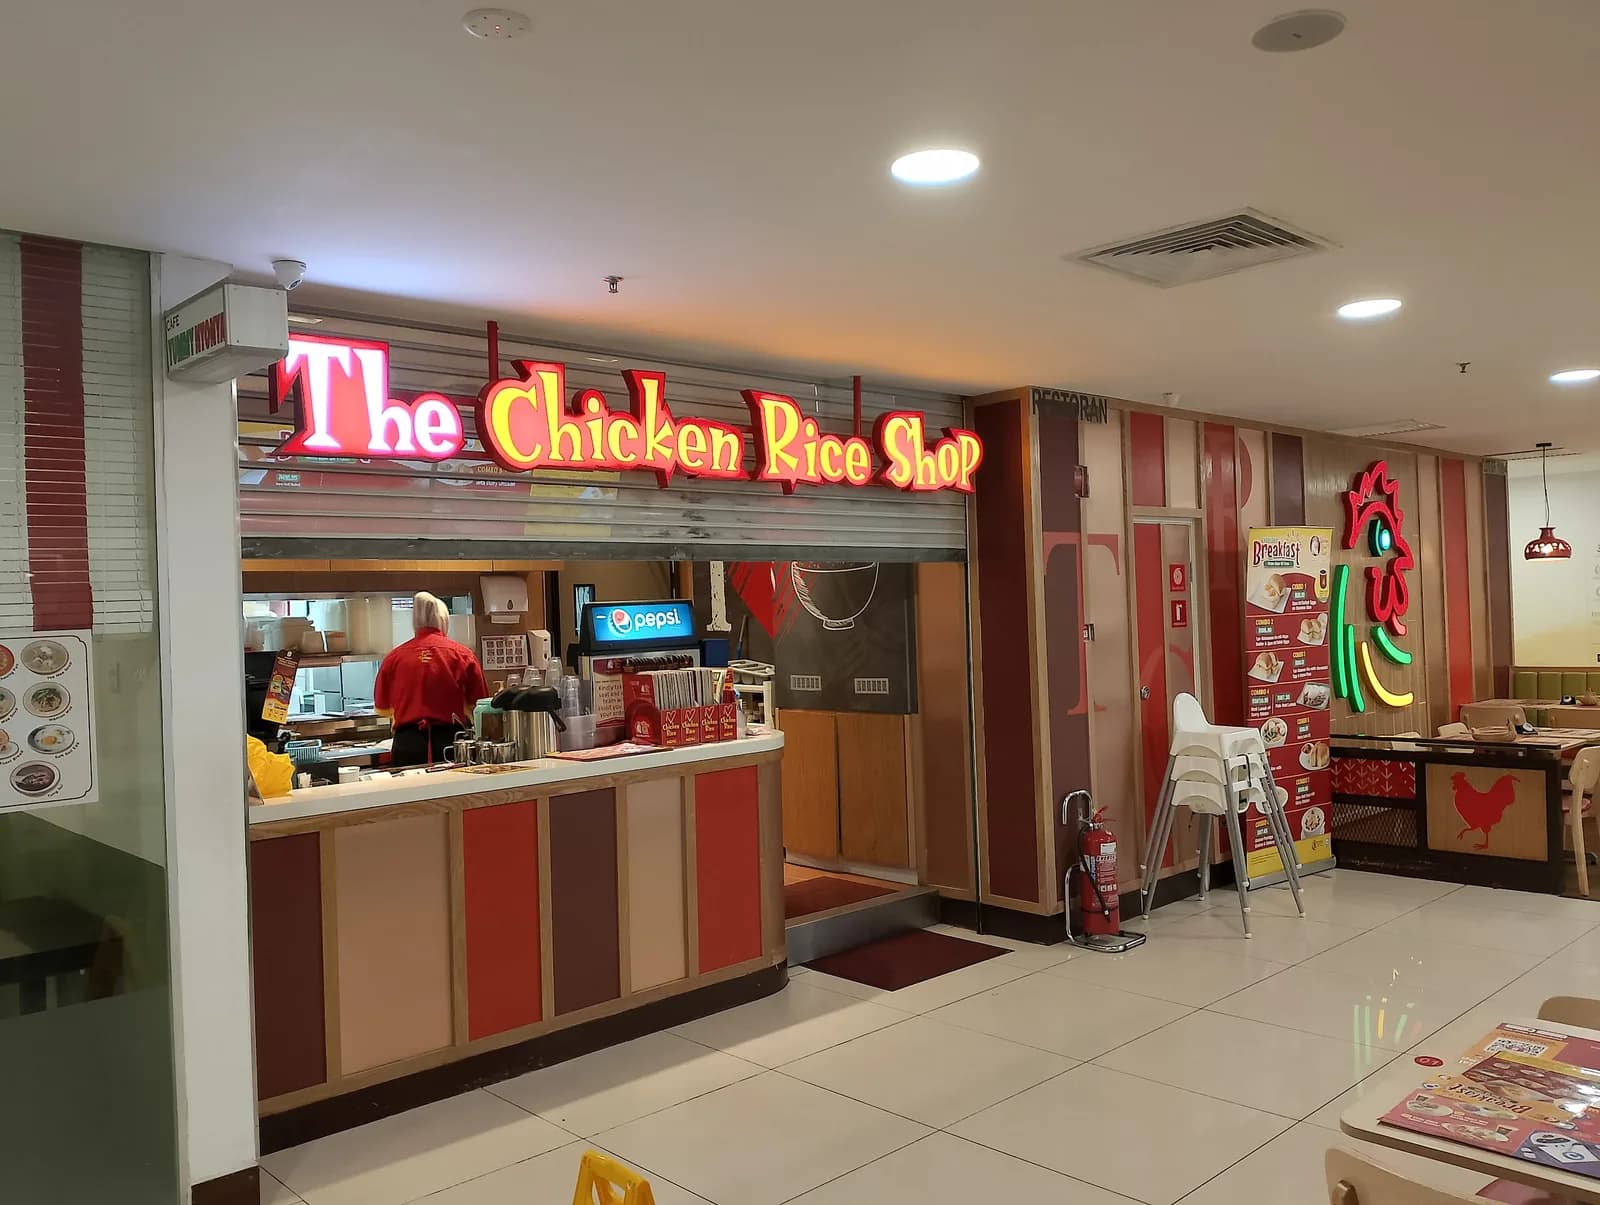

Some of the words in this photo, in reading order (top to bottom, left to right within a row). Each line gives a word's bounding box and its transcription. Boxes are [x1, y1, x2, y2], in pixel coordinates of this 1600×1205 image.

[166, 314, 180, 331] CAFE
[285, 339, 458, 455] The
[490, 370, 740, 472] Chicken
[760, 399, 869, 481] Rice
[1252, 540, 1301, 568] Breakfast
[634, 608, 681, 632] pepsi
